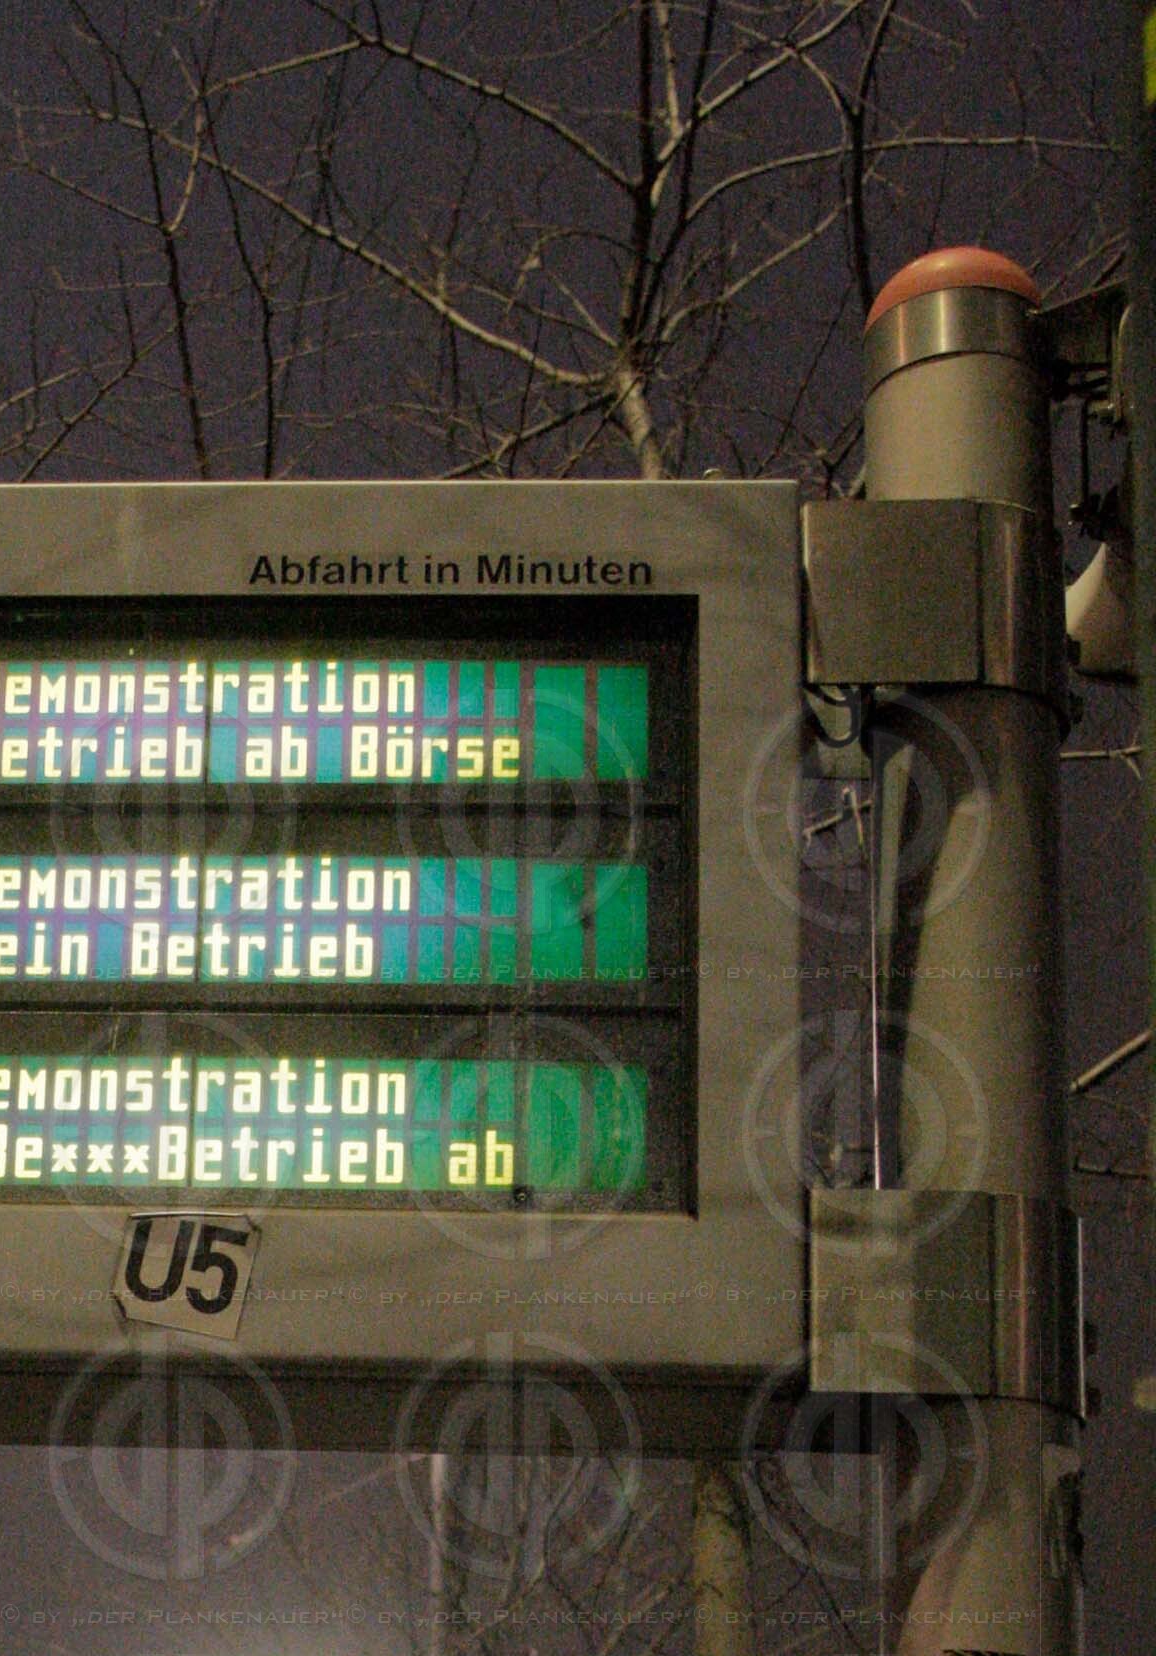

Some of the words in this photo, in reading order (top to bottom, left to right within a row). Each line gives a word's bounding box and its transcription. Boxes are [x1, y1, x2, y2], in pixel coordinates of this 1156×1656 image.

[249, 555, 408, 585] Abfahrt
[423, 555, 460, 585] in
[477, 554, 653, 586] Minuten
[245, 725, 308, 778] ab
[351, 725, 520, 778] Börse
[131, 921, 374, 978] Betrieb
[448, 1130, 514, 1186] ab
[125, 1220, 249, 1314] U5
